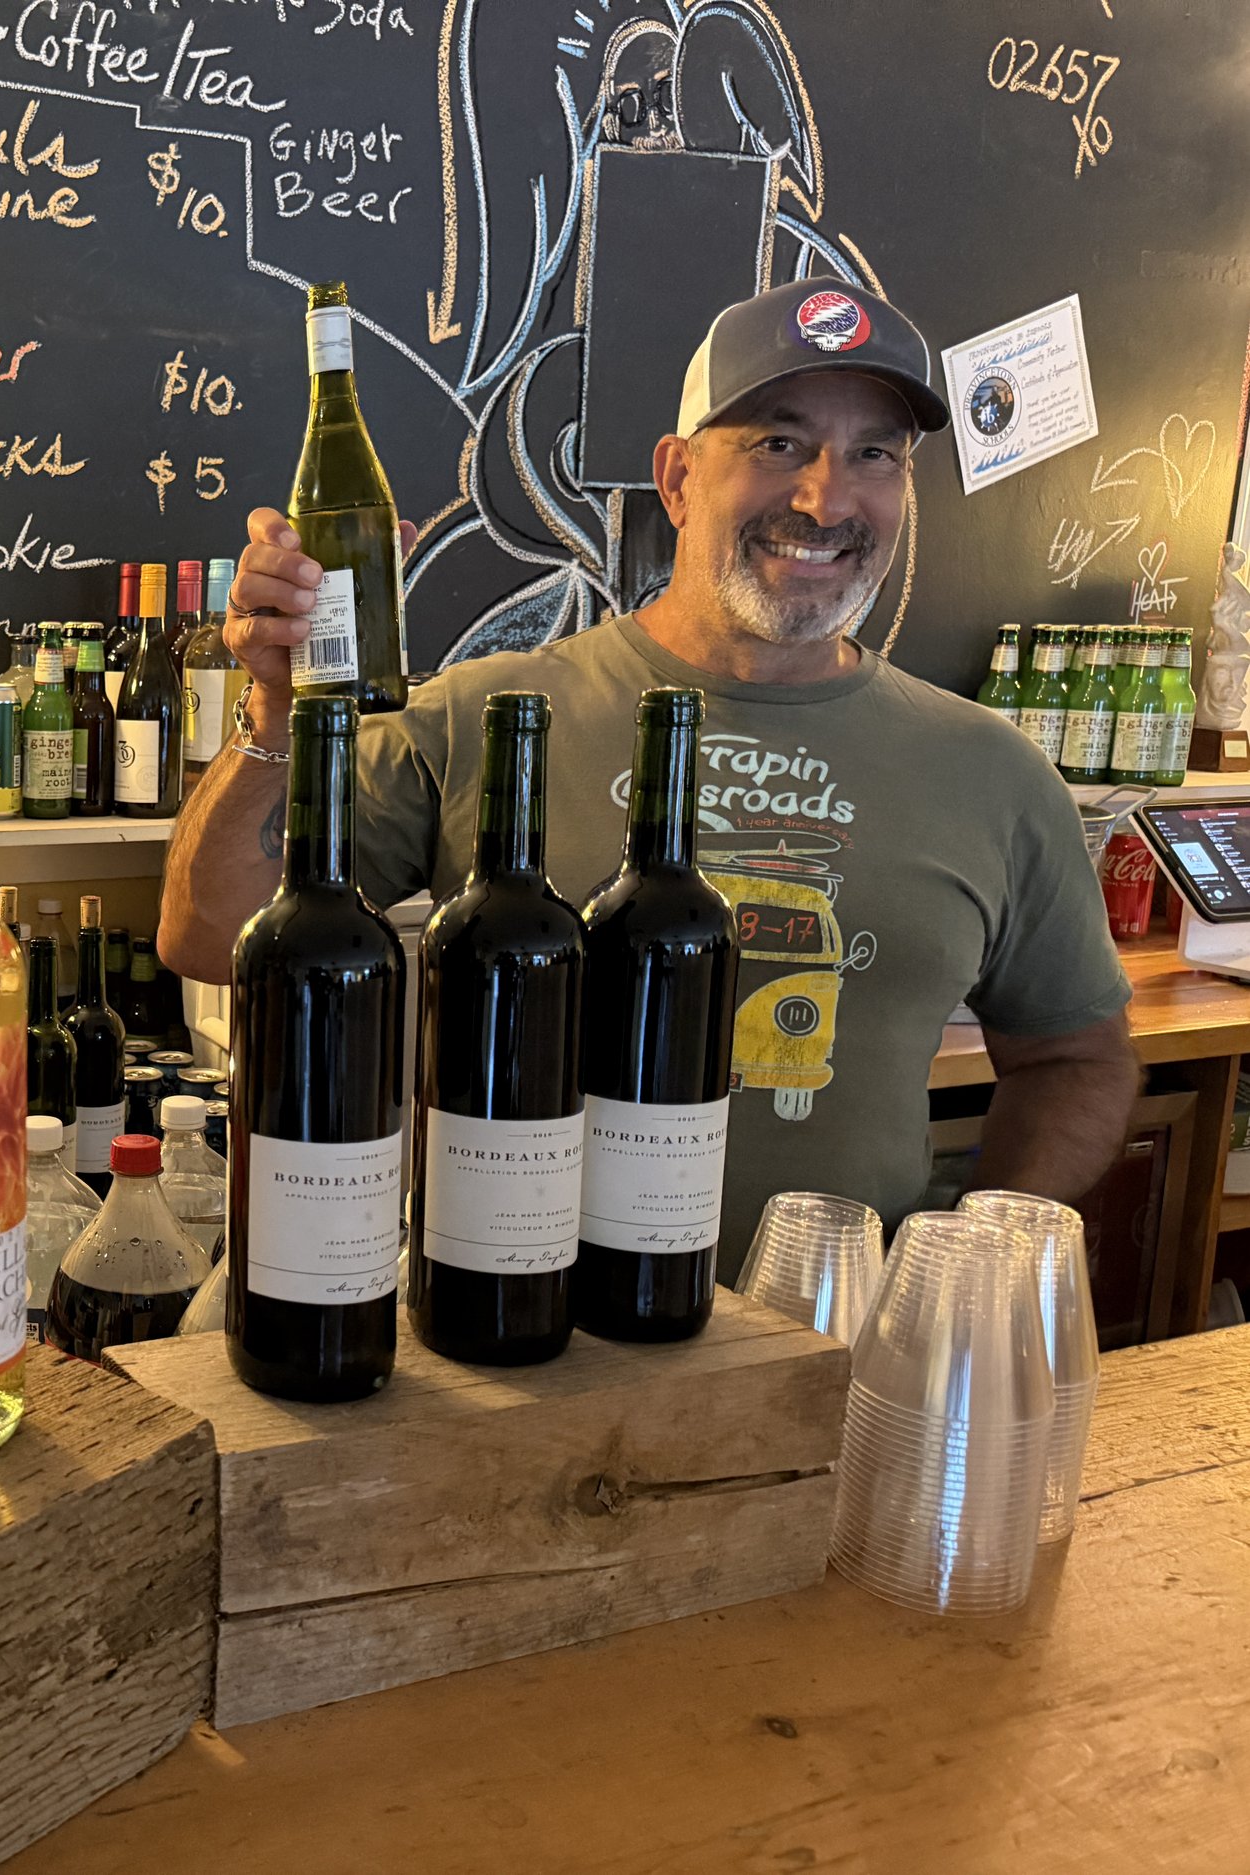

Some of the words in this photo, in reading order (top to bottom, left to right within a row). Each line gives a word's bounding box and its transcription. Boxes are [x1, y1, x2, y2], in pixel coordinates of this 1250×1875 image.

[269, 122, 403, 184] Ginger
[274, 171, 413, 224] Beer
[964, 366, 1018, 411] PROVINCETOWN
[593, 1127, 701, 1145] BORDEAUX
[448, 1145, 559, 1162] BORDEAUX
[602, 1147, 662, 1158] APPELLATION
[666, 1151, 706, 1159] BORDEAUX
[457, 1165, 518, 1176] APPELLATION
[522, 1168, 564, 1177] BORDEAUX
[274, 1171, 383, 1187] BORDEAUX
[285, 1193, 347, 1202] APPELLATION
[632, 1205, 685, 1213] VITICULTEUR
[489, 1224, 543, 1232] VITICULTEUR
[319, 1251, 372, 1260] VITICULTEUR
